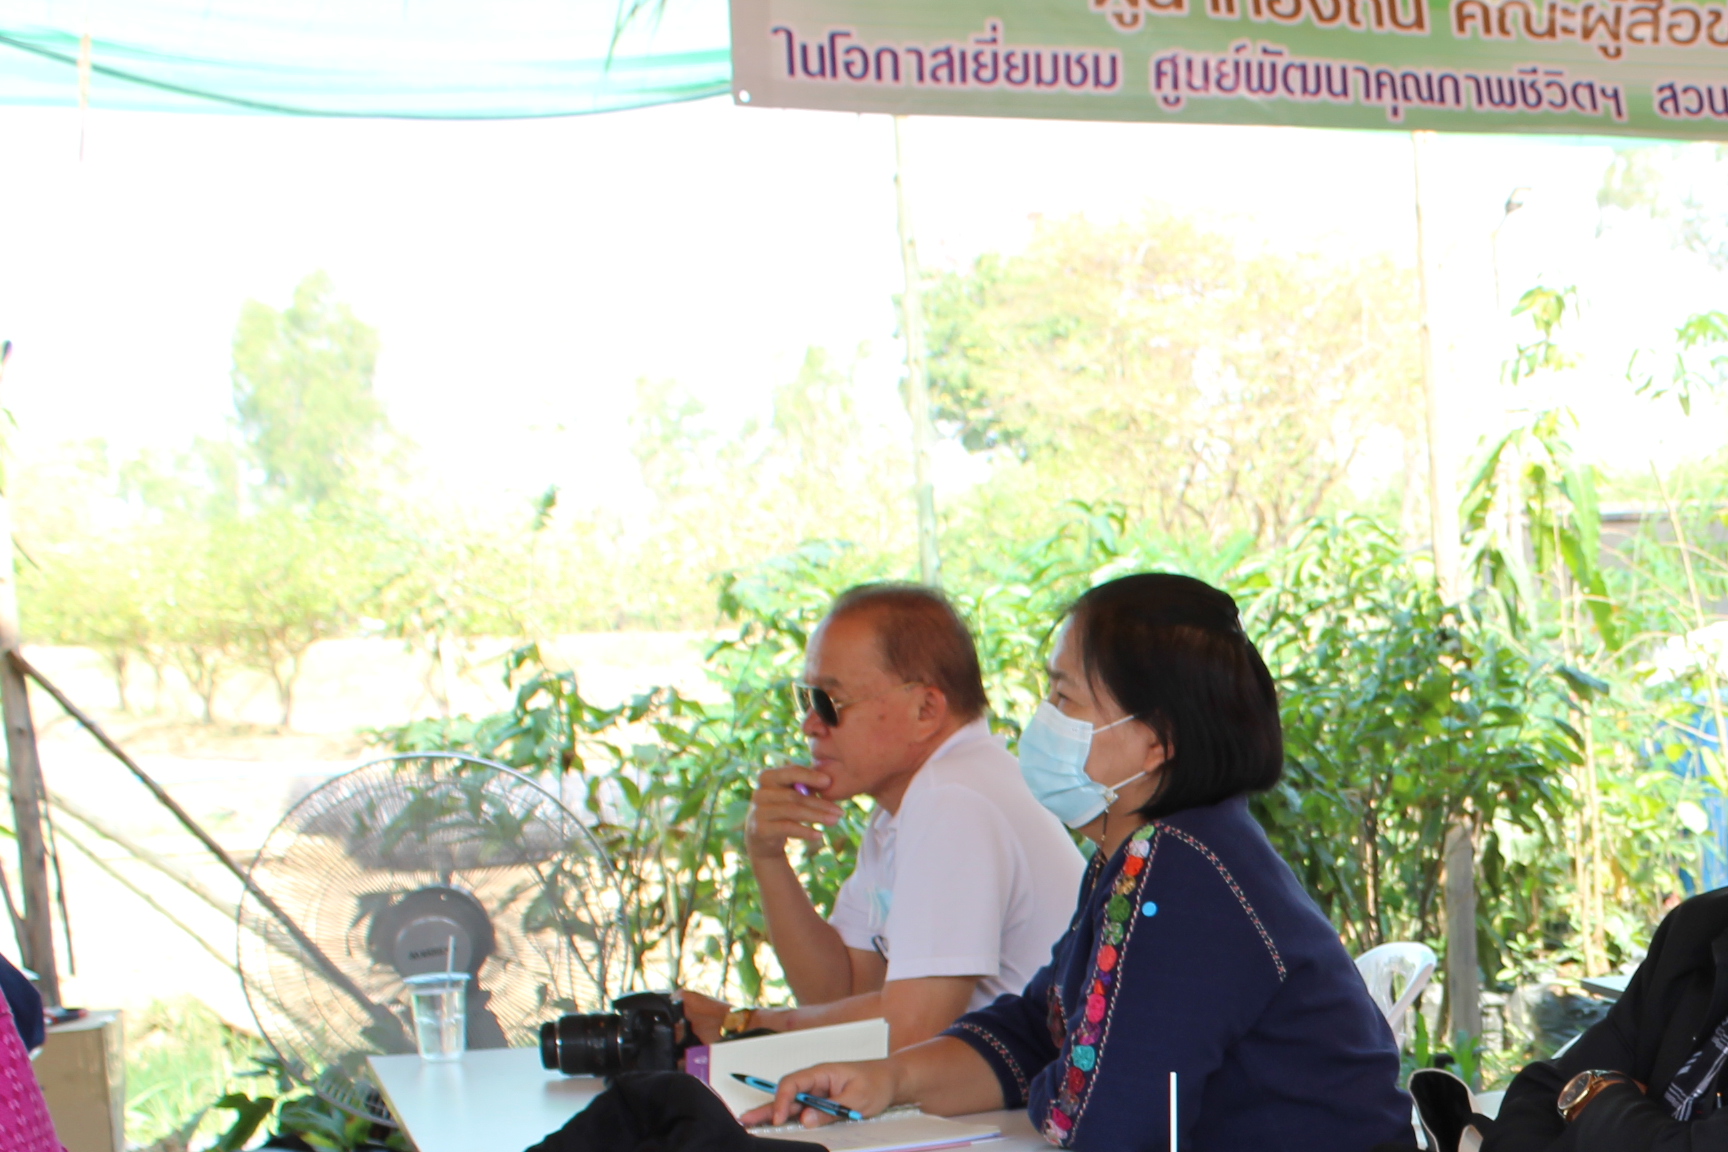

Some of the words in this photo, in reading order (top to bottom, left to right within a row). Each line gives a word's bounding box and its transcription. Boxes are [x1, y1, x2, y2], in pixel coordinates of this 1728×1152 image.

[771, 24, 1118, 88] ในโอกาสเยี่ยมชม
[1155, 45, 1622, 118] ศูนย์พัฒนาคุณภาพชีวิตฯ
